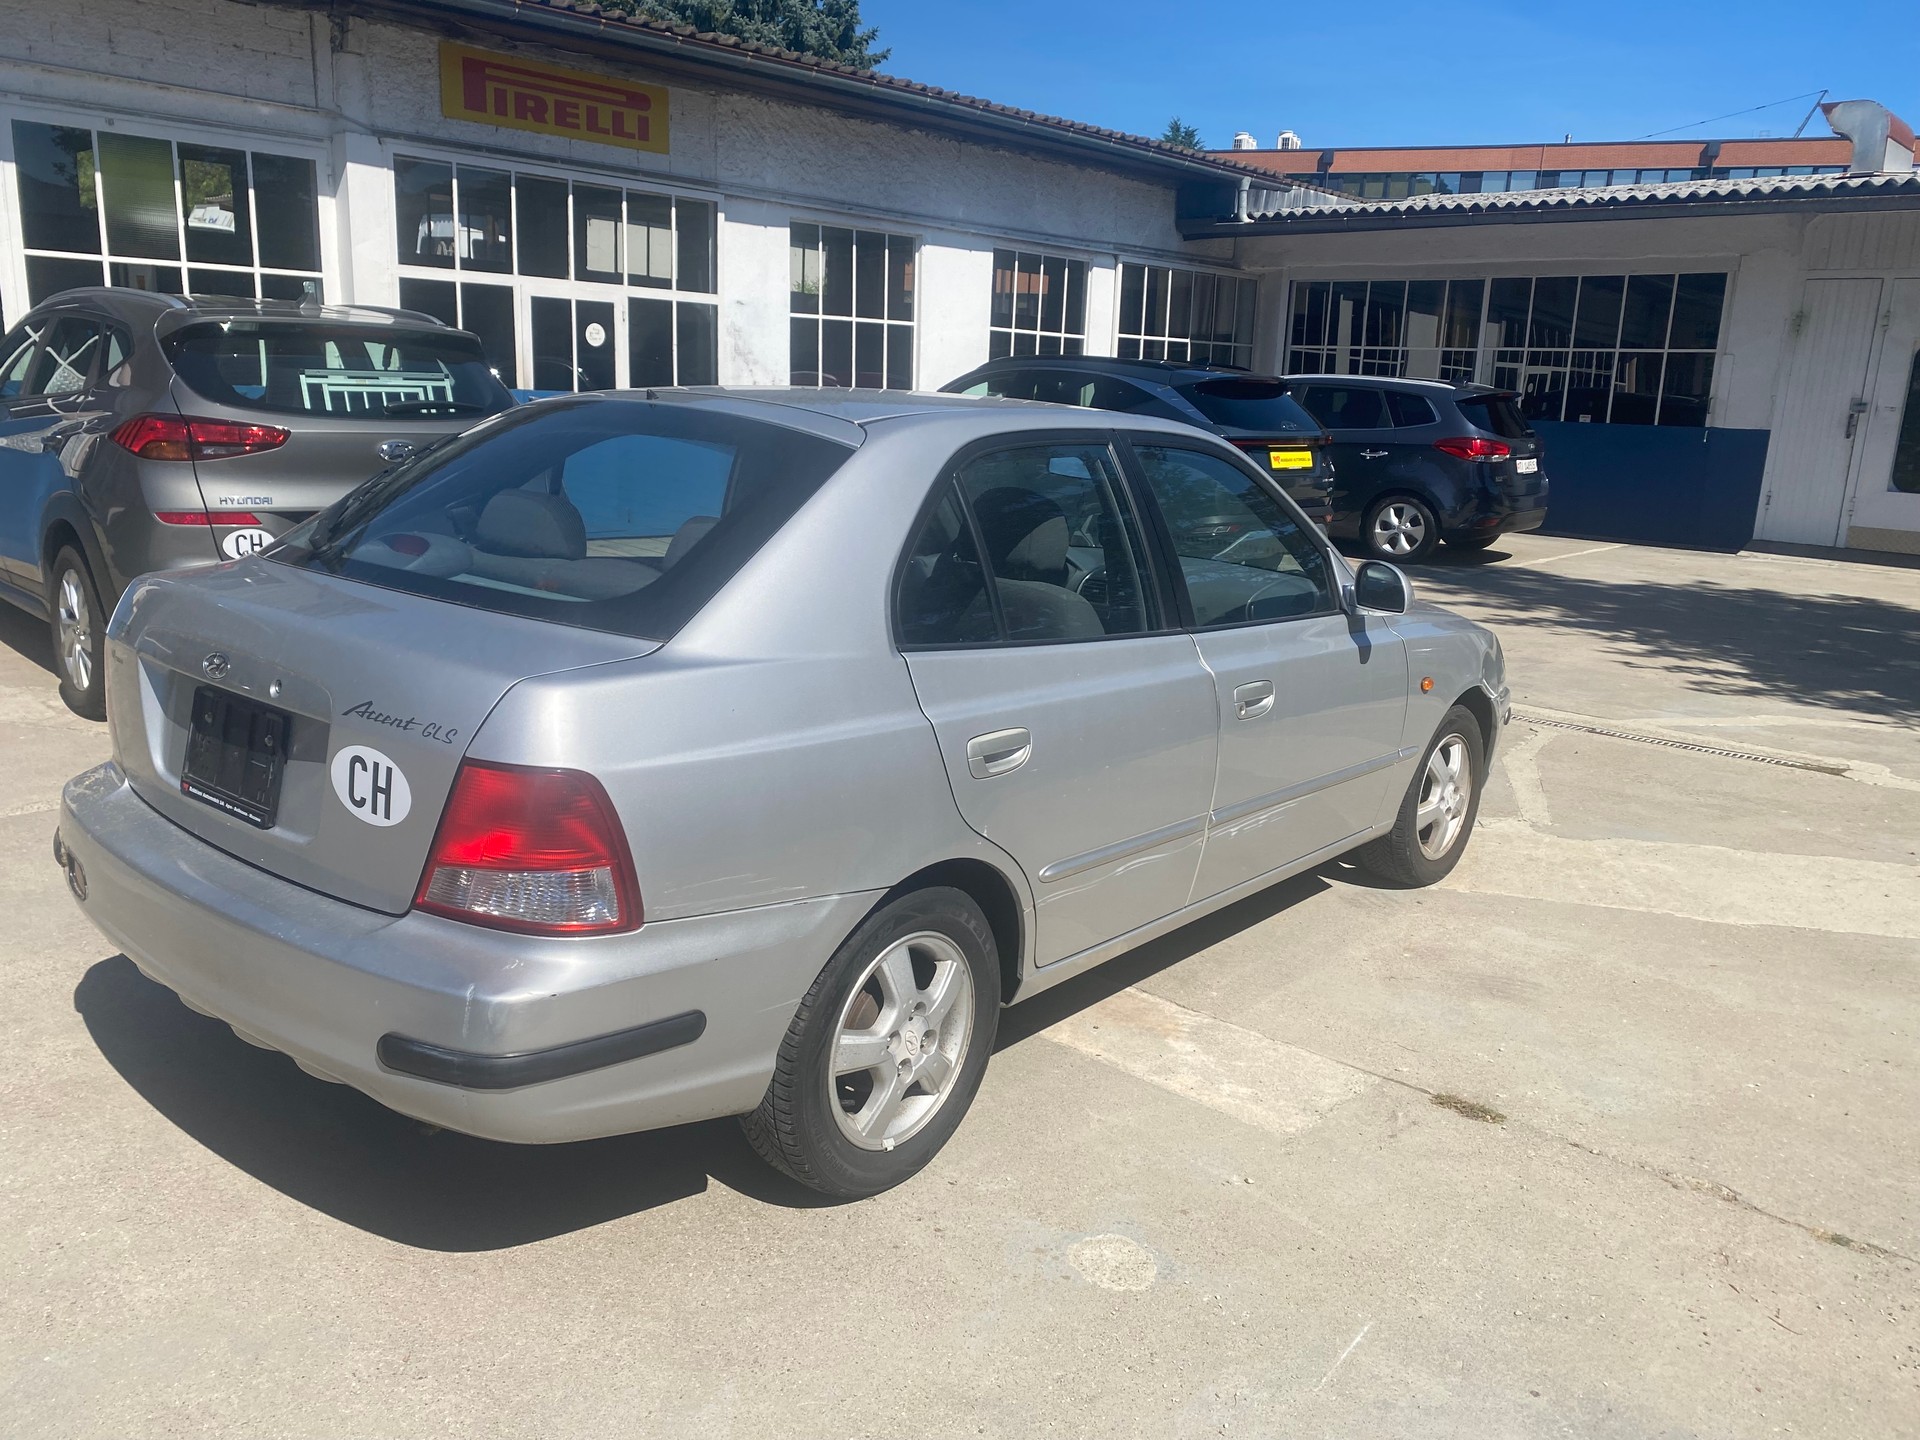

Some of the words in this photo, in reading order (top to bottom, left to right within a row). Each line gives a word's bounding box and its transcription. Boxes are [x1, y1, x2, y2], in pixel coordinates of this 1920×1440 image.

[462, 56, 651, 142] PIRELLI
[219, 496, 273, 506] HYUNDAI
[235, 533, 264, 556] CH
[341, 700, 424, 731] Accent
[421, 722, 458, 745] GLS
[348, 754, 393, 820] CH
